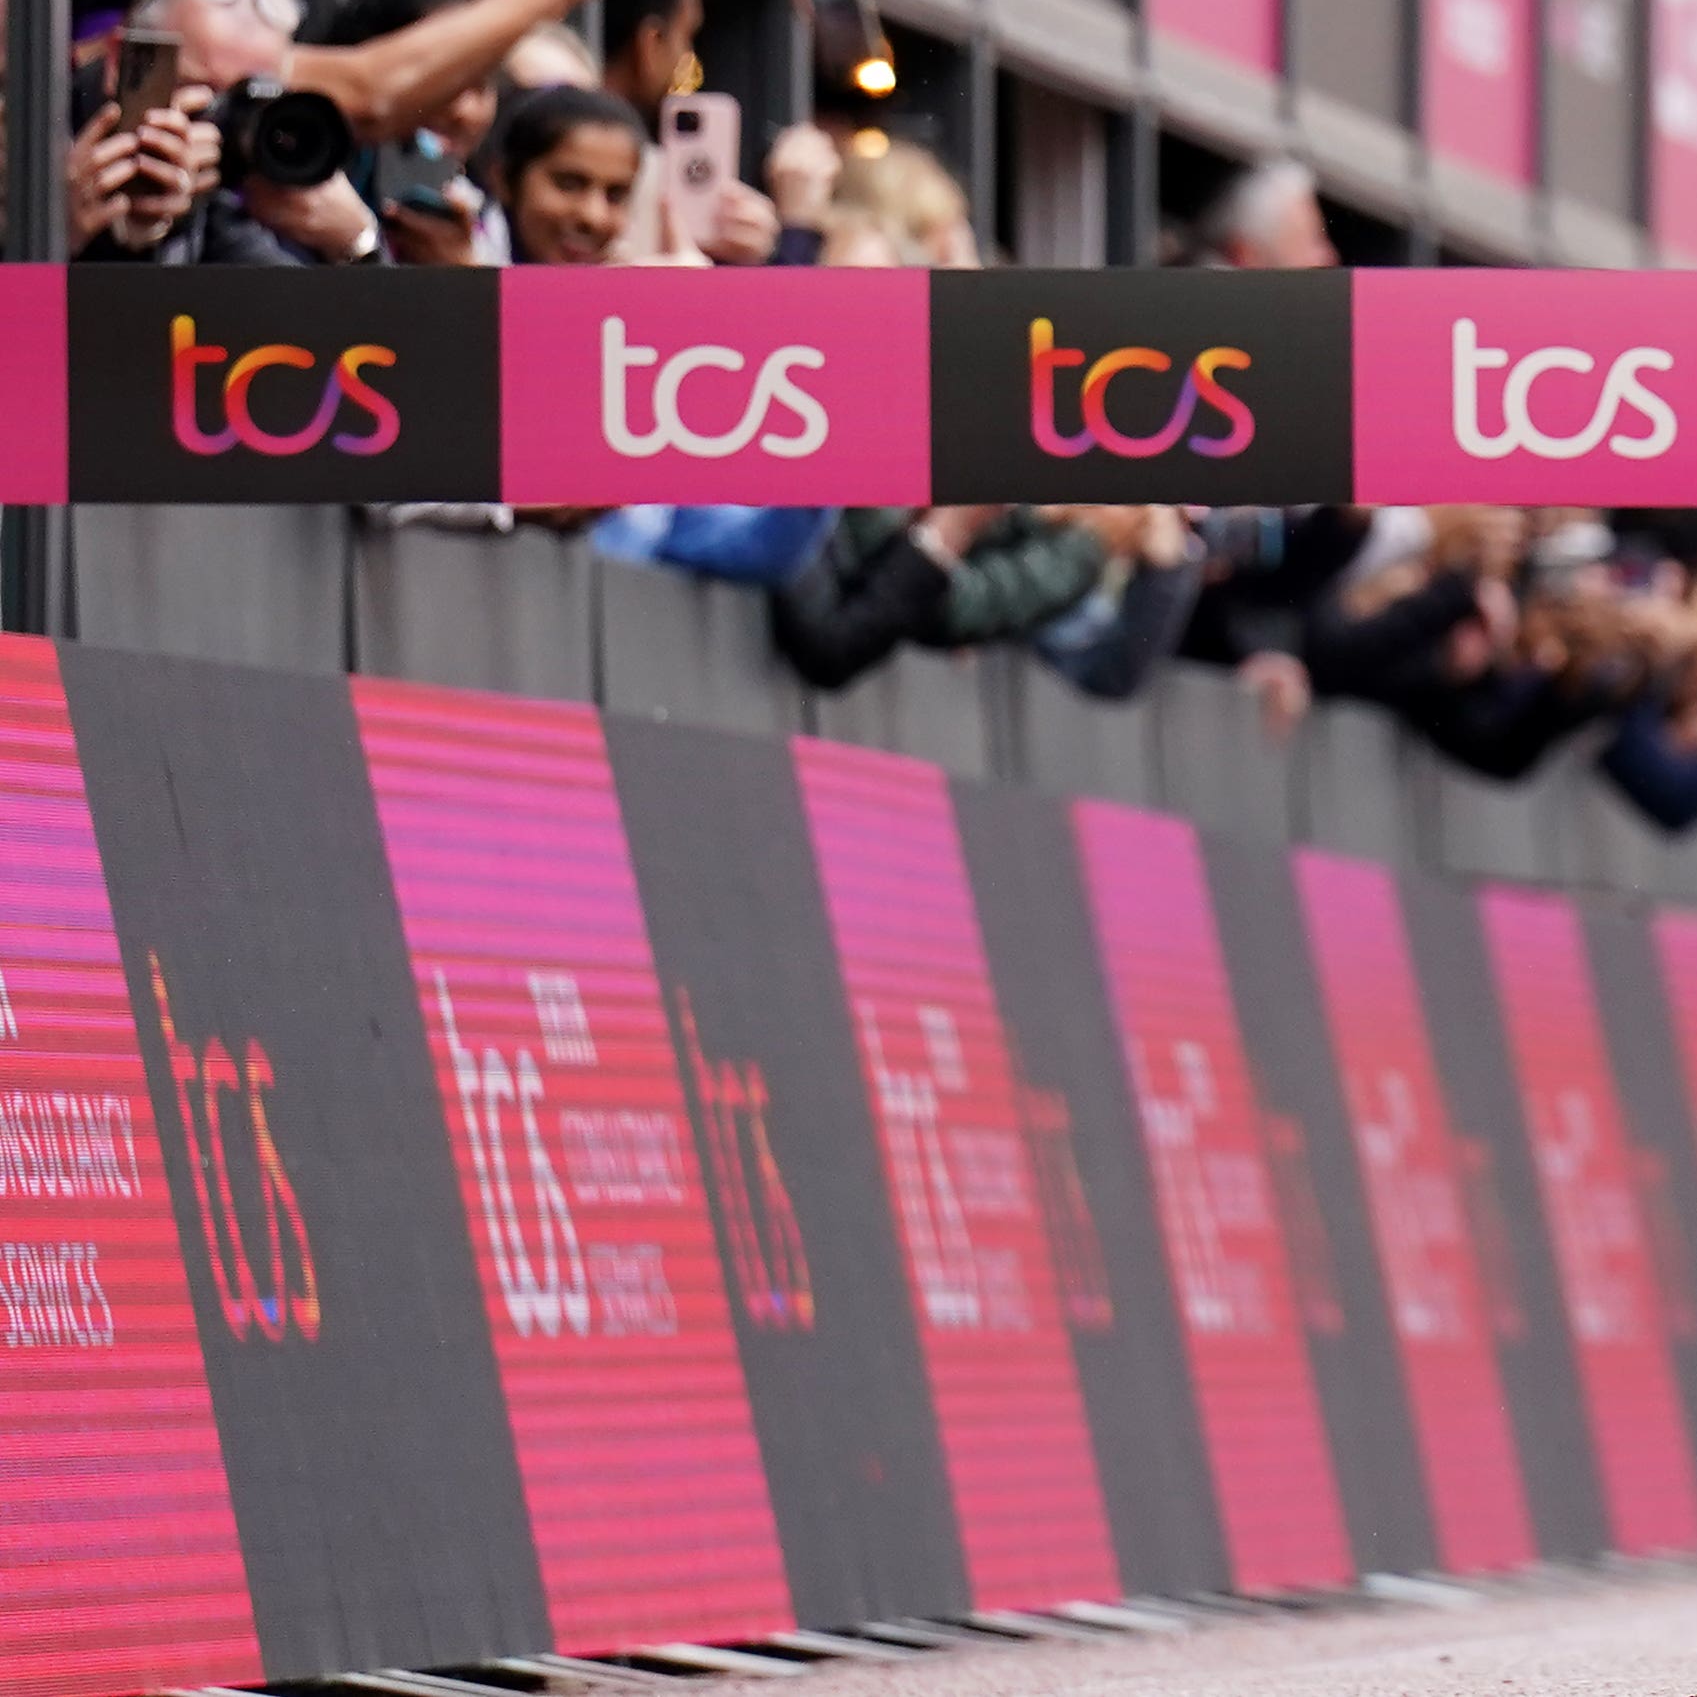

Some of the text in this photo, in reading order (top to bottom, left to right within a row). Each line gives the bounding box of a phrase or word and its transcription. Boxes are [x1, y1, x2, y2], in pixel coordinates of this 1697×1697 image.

[170, 315, 400, 456] tcs
[604, 316, 829, 458] tcs
[1029, 317, 1256, 459] tcs
[1452, 318, 1677, 460] tcs
[0, 1090, 142, 1198] NSULTANCY
[147, 949, 321, 1344] tcs
[434, 966, 591, 1339] tcs
